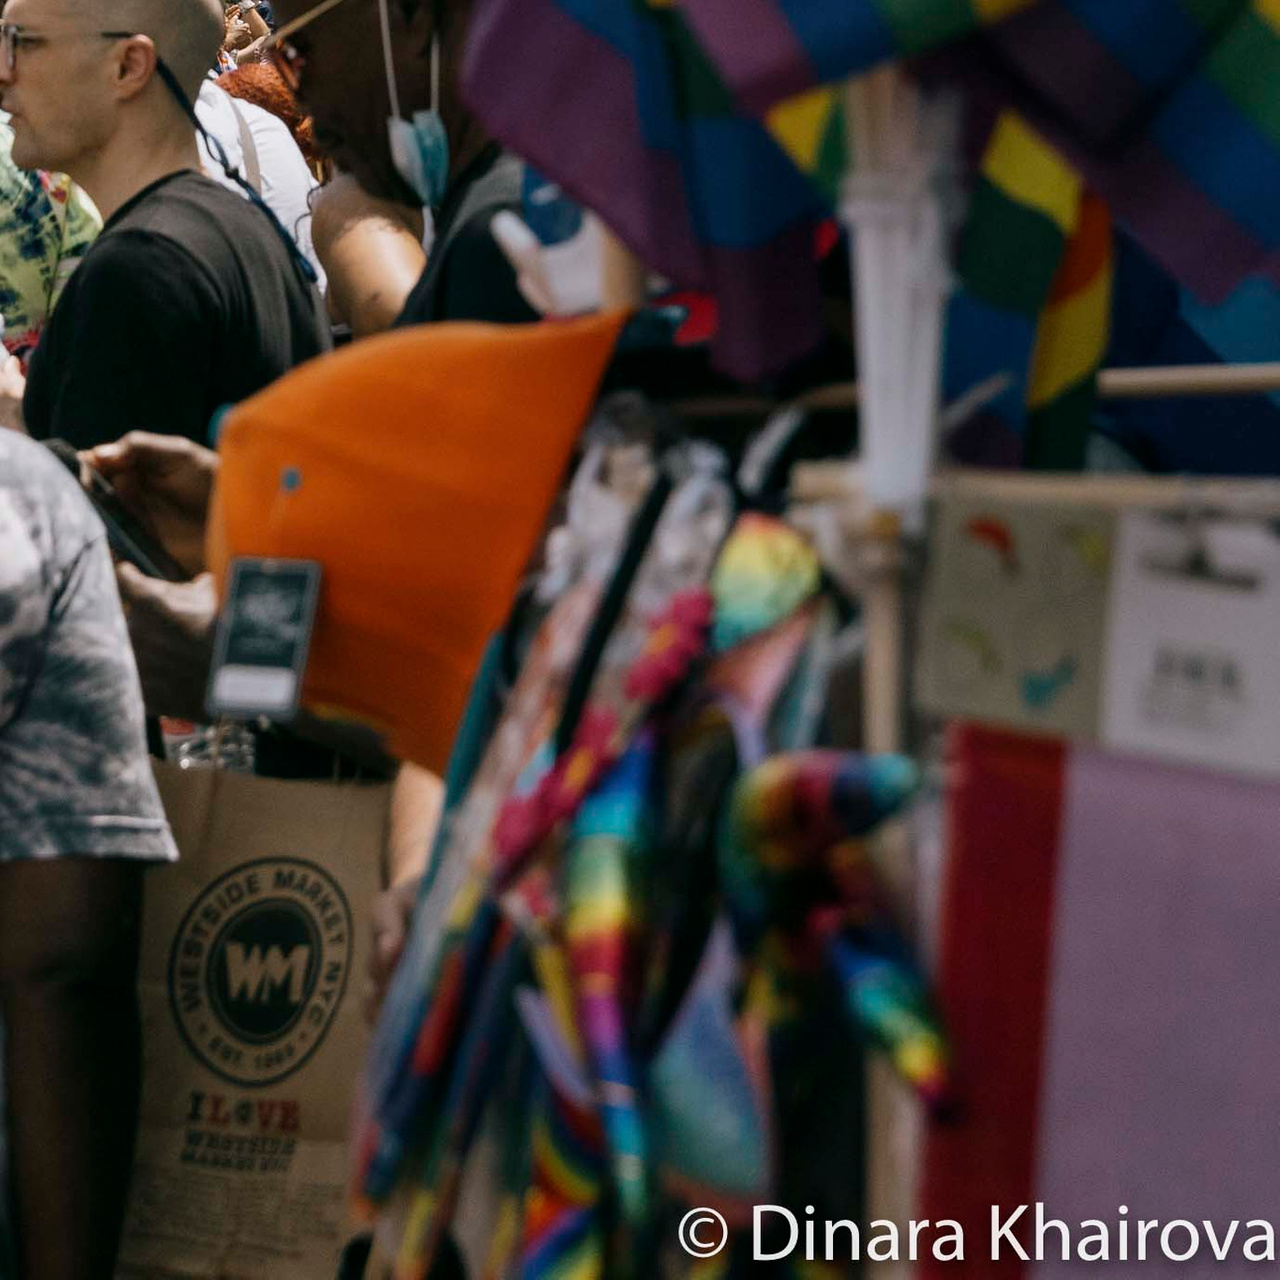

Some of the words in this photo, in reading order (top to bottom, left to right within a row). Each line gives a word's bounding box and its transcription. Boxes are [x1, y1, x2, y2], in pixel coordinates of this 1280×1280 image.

[180, 872, 260, 1014] WESTSIDE
[274, 868, 345, 946] MARKET
[224, 942, 311, 1004] WM
[207, 1093, 300, 1133] LOVE
